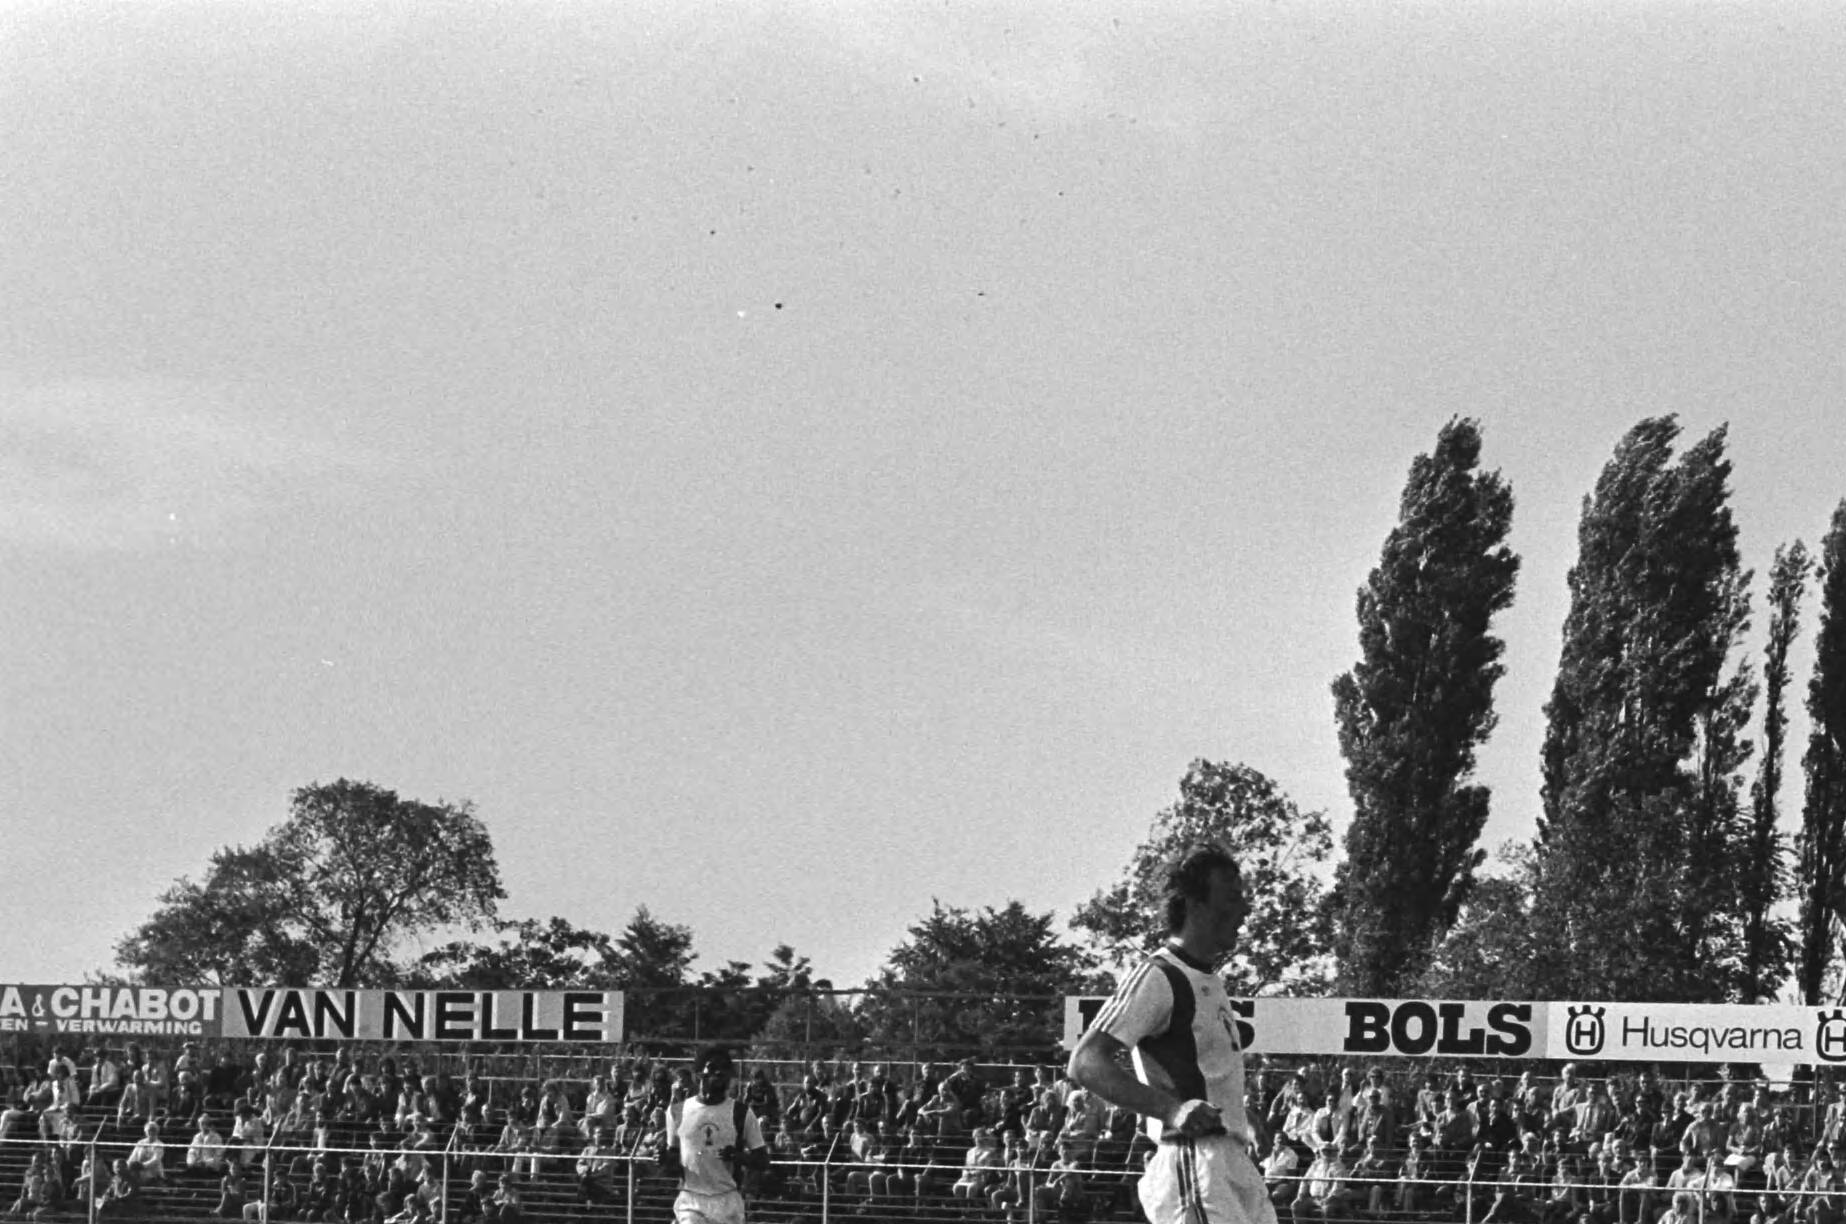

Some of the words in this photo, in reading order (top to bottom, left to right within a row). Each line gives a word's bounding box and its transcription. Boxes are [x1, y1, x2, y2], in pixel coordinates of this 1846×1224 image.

[51, 987, 221, 1020] CHABOT
[237, 990, 361, 1038] VAN
[383, 991, 608, 1040] NELLE
[56, 1019, 203, 1034] VERWARMING
[1344, 1001, 1533, 1056] BOLS
[1621, 1015, 1804, 1053] Husqvarna
